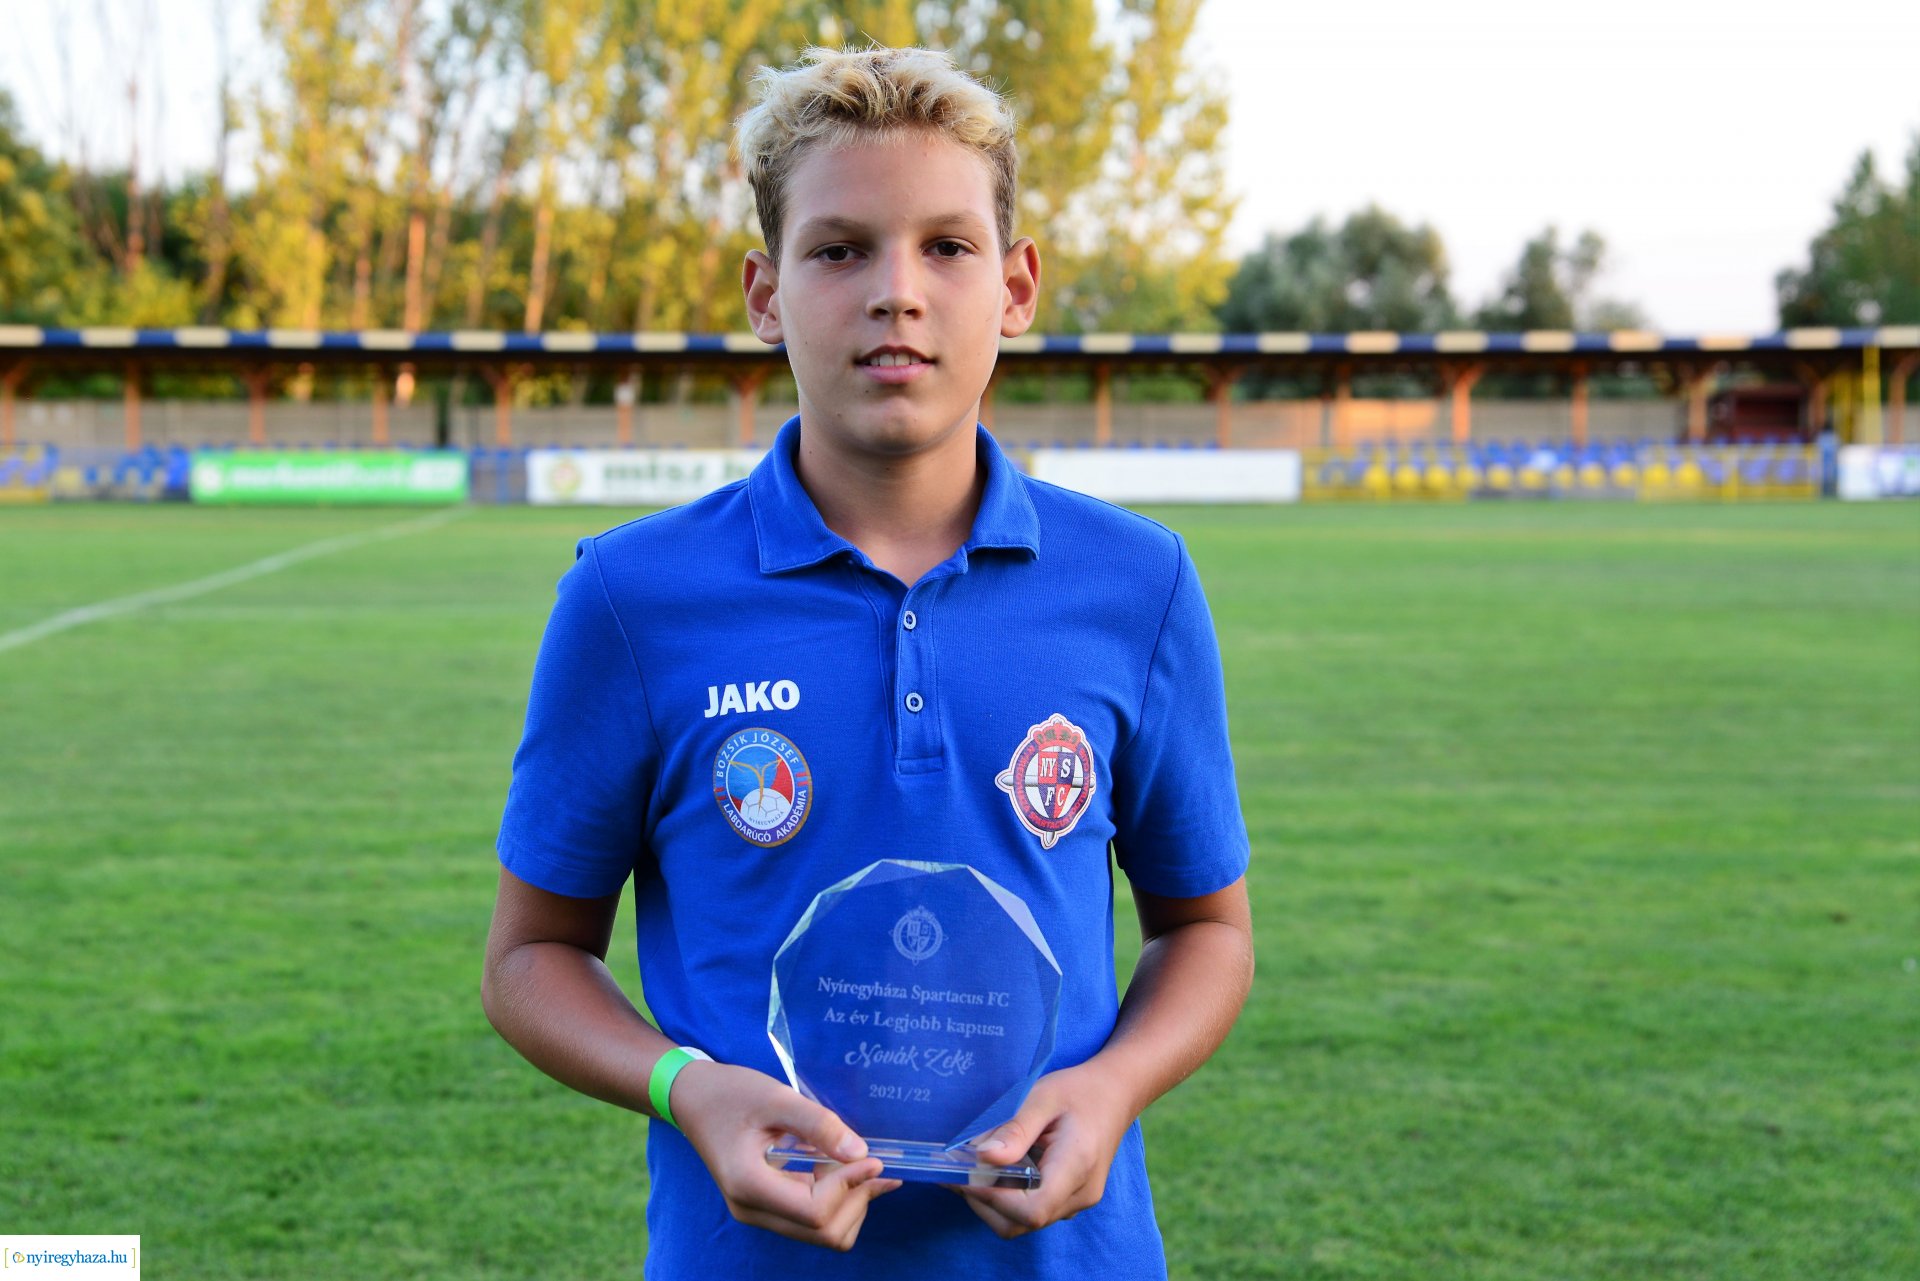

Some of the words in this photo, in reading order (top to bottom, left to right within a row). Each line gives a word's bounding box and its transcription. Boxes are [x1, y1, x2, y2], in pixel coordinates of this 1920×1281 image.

[704, 679, 801, 718] JAKO
[716, 733, 748, 778] BOZSIK
[752, 731, 799, 765] JÓZSEF
[1040, 757, 1057, 777] NY
[1060, 758, 1071, 778] S
[1045, 786, 1056, 807] F
[1057, 786, 1066, 807] C
[723, 803, 772, 843] LABDARÚGÓ
[776, 790, 807, 840] AKADÉMIA
[817, 976, 908, 1000] Nyíregyháza
[911, 984, 984, 1005] Spartacus
[986, 991, 1010, 1008] FC
[824, 1007, 845, 1024] Az
[849, 1009, 869, 1025] év
[873, 1011, 941, 1034] Legjobb
[946, 1017, 1005, 1038] kapusa
[844, 1041, 919, 1072] Novák
[869, 1084, 931, 1103] 2021/22
